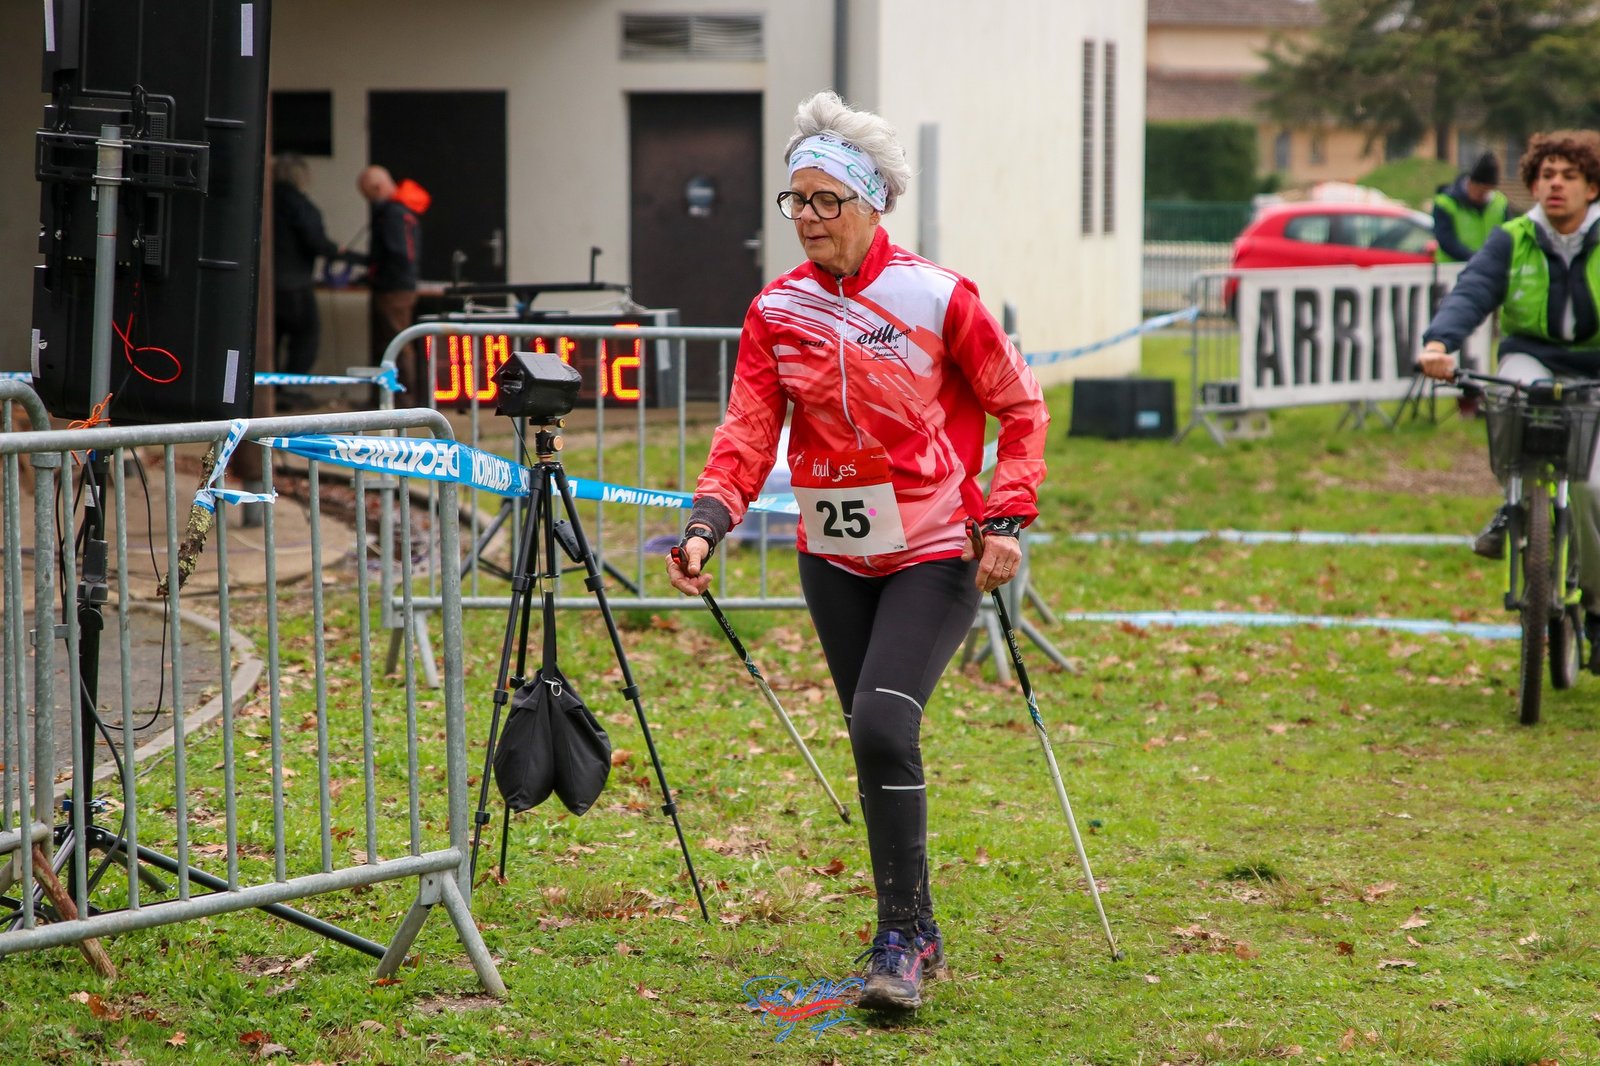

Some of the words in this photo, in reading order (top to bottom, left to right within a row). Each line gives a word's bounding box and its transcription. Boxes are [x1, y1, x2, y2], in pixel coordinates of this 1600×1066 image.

[1256, 283, 1479, 387] ARRIV
[329, 438, 460, 478] DECATHLON
[816, 500, 871, 539] 25
